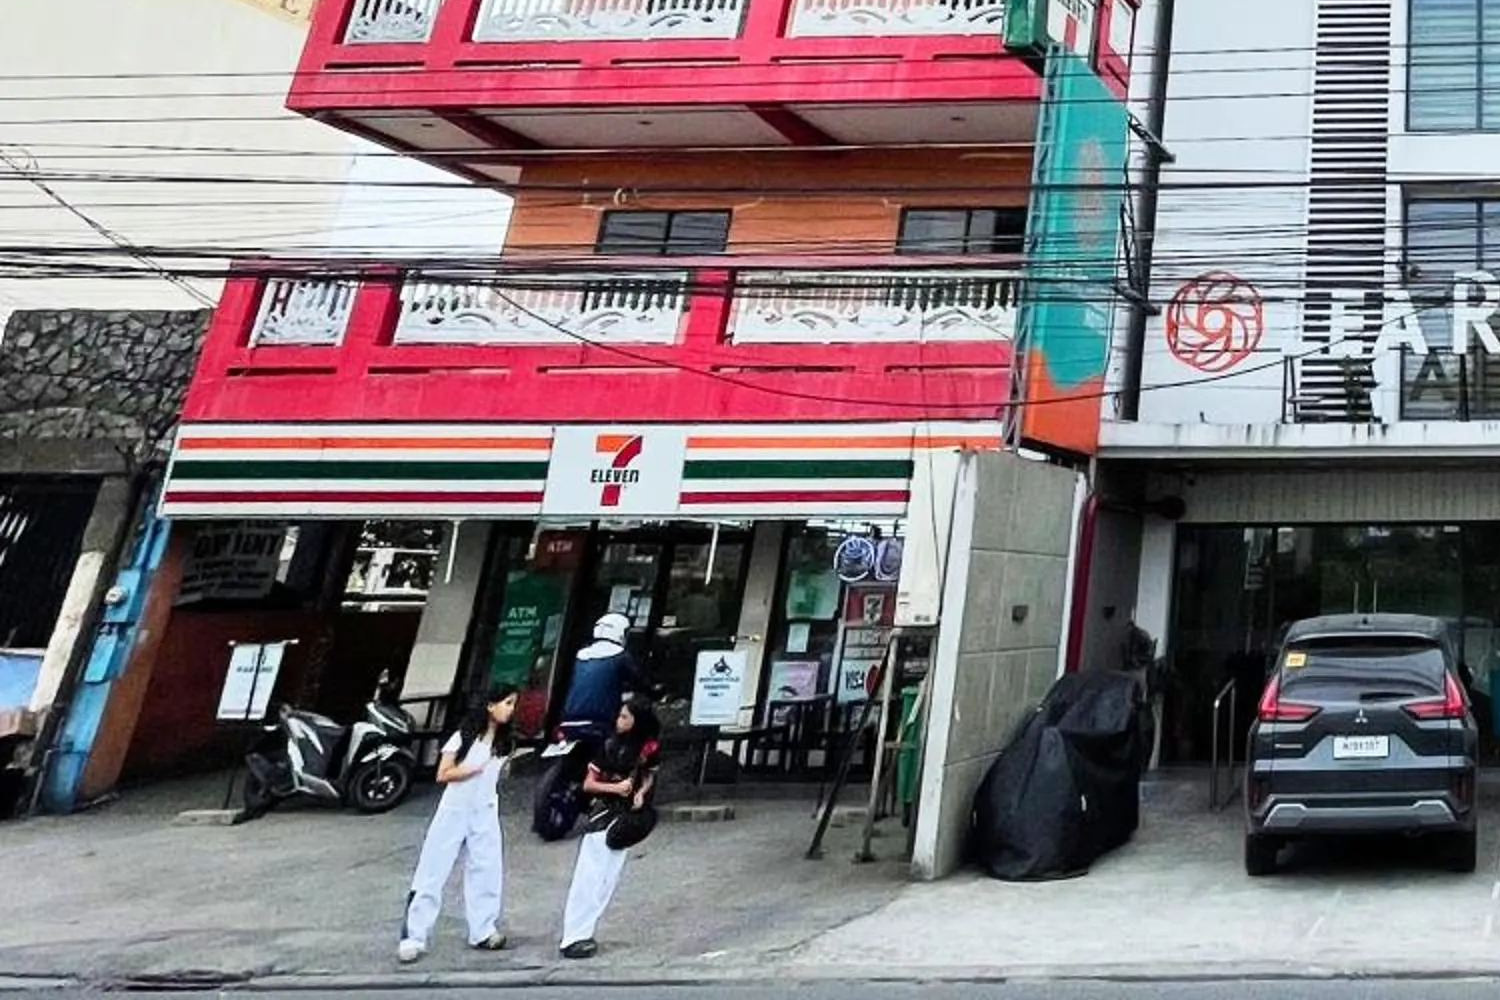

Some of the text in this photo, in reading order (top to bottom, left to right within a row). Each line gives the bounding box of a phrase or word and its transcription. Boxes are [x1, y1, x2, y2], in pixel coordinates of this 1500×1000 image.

[595, 435, 643, 506] 7
[547, 540, 574, 552] ATM
[507, 606, 538, 619] ATM
